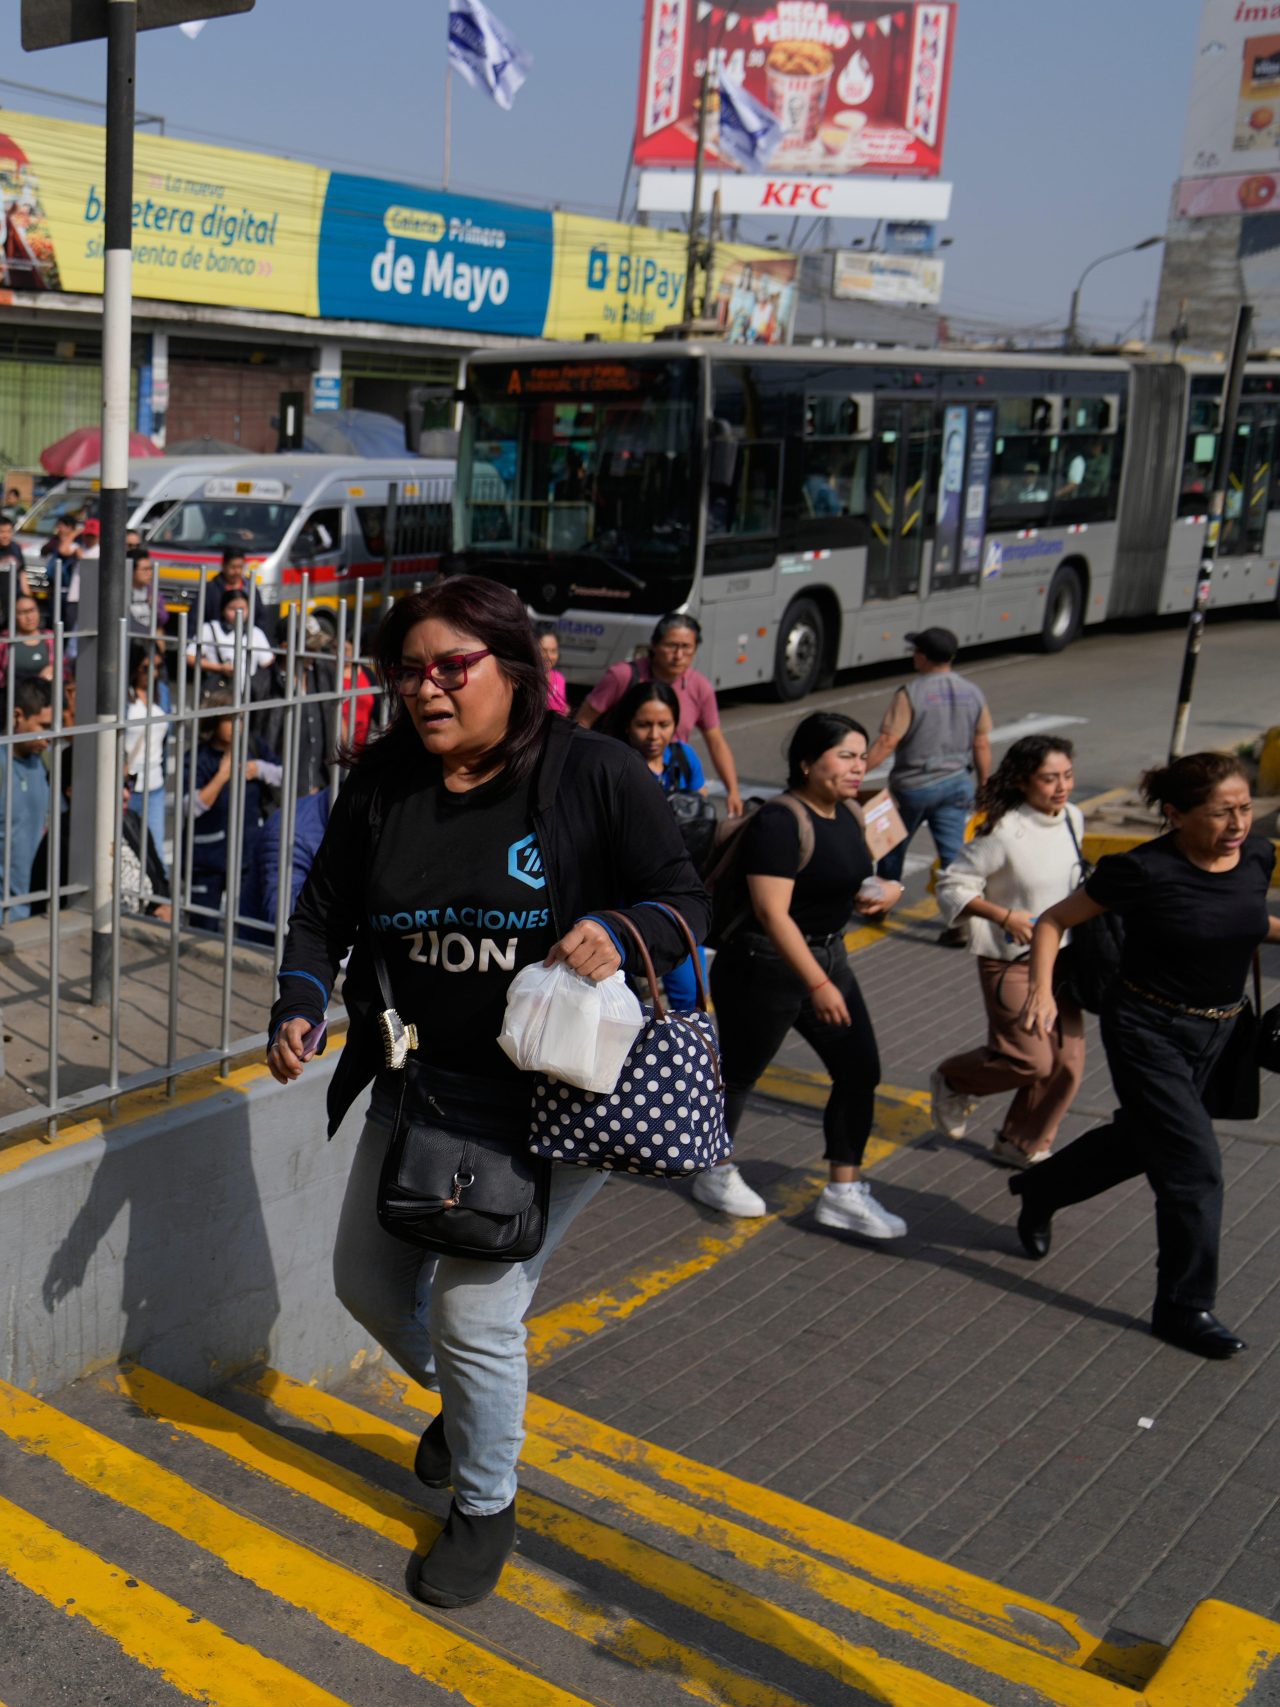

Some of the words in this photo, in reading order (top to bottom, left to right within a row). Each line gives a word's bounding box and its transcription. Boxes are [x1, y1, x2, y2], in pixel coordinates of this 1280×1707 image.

[752, 18, 850, 49] PERUANO
[760, 181, 833, 209] KFC
[200, 203, 279, 247] digital
[449, 217, 506, 249] Primero
[181, 245, 203, 271] de
[206, 248, 256, 276] banco
[371, 238, 415, 294] de
[421, 248, 509, 312] Mayo
[617, 254, 686, 309] BiPay
[507, 368, 521, 395] A
[400, 930, 519, 973] ZION
